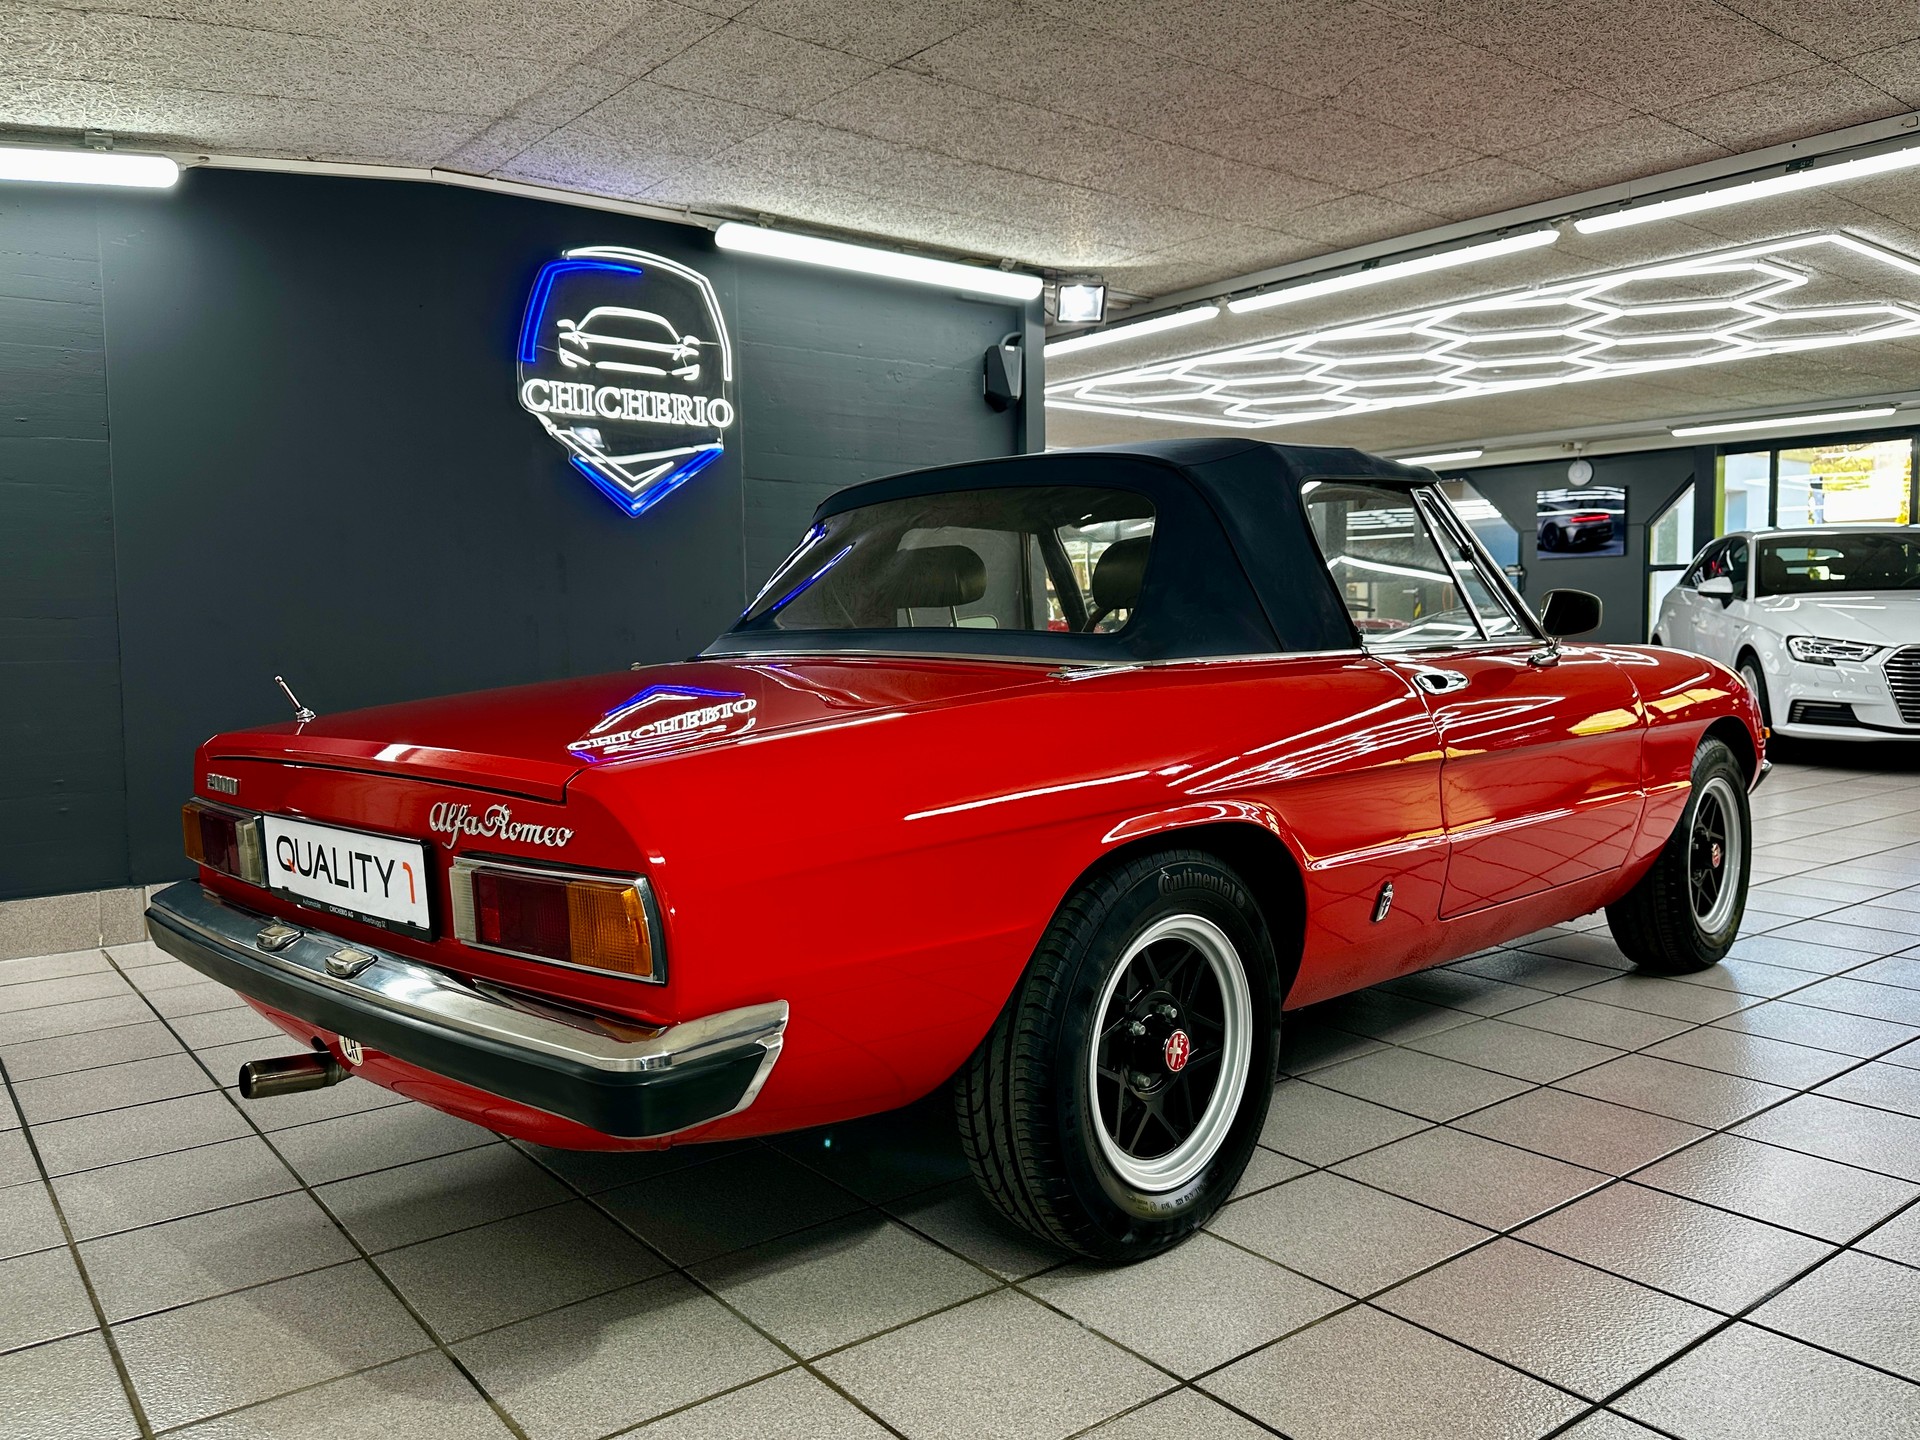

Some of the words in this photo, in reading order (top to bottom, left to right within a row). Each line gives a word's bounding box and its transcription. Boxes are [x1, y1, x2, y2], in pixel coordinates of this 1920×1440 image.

[522, 378, 734, 428] CHICHERIO
[207, 773, 238, 795] 2000
[429, 801, 479, 849] Alfa
[479, 804, 575, 847] Romeo
[276, 835, 395, 898] QUALITY
[402, 861, 416, 904] 1
[1158, 868, 1236, 900] Continental
[344, 1036, 360, 1061] CH
